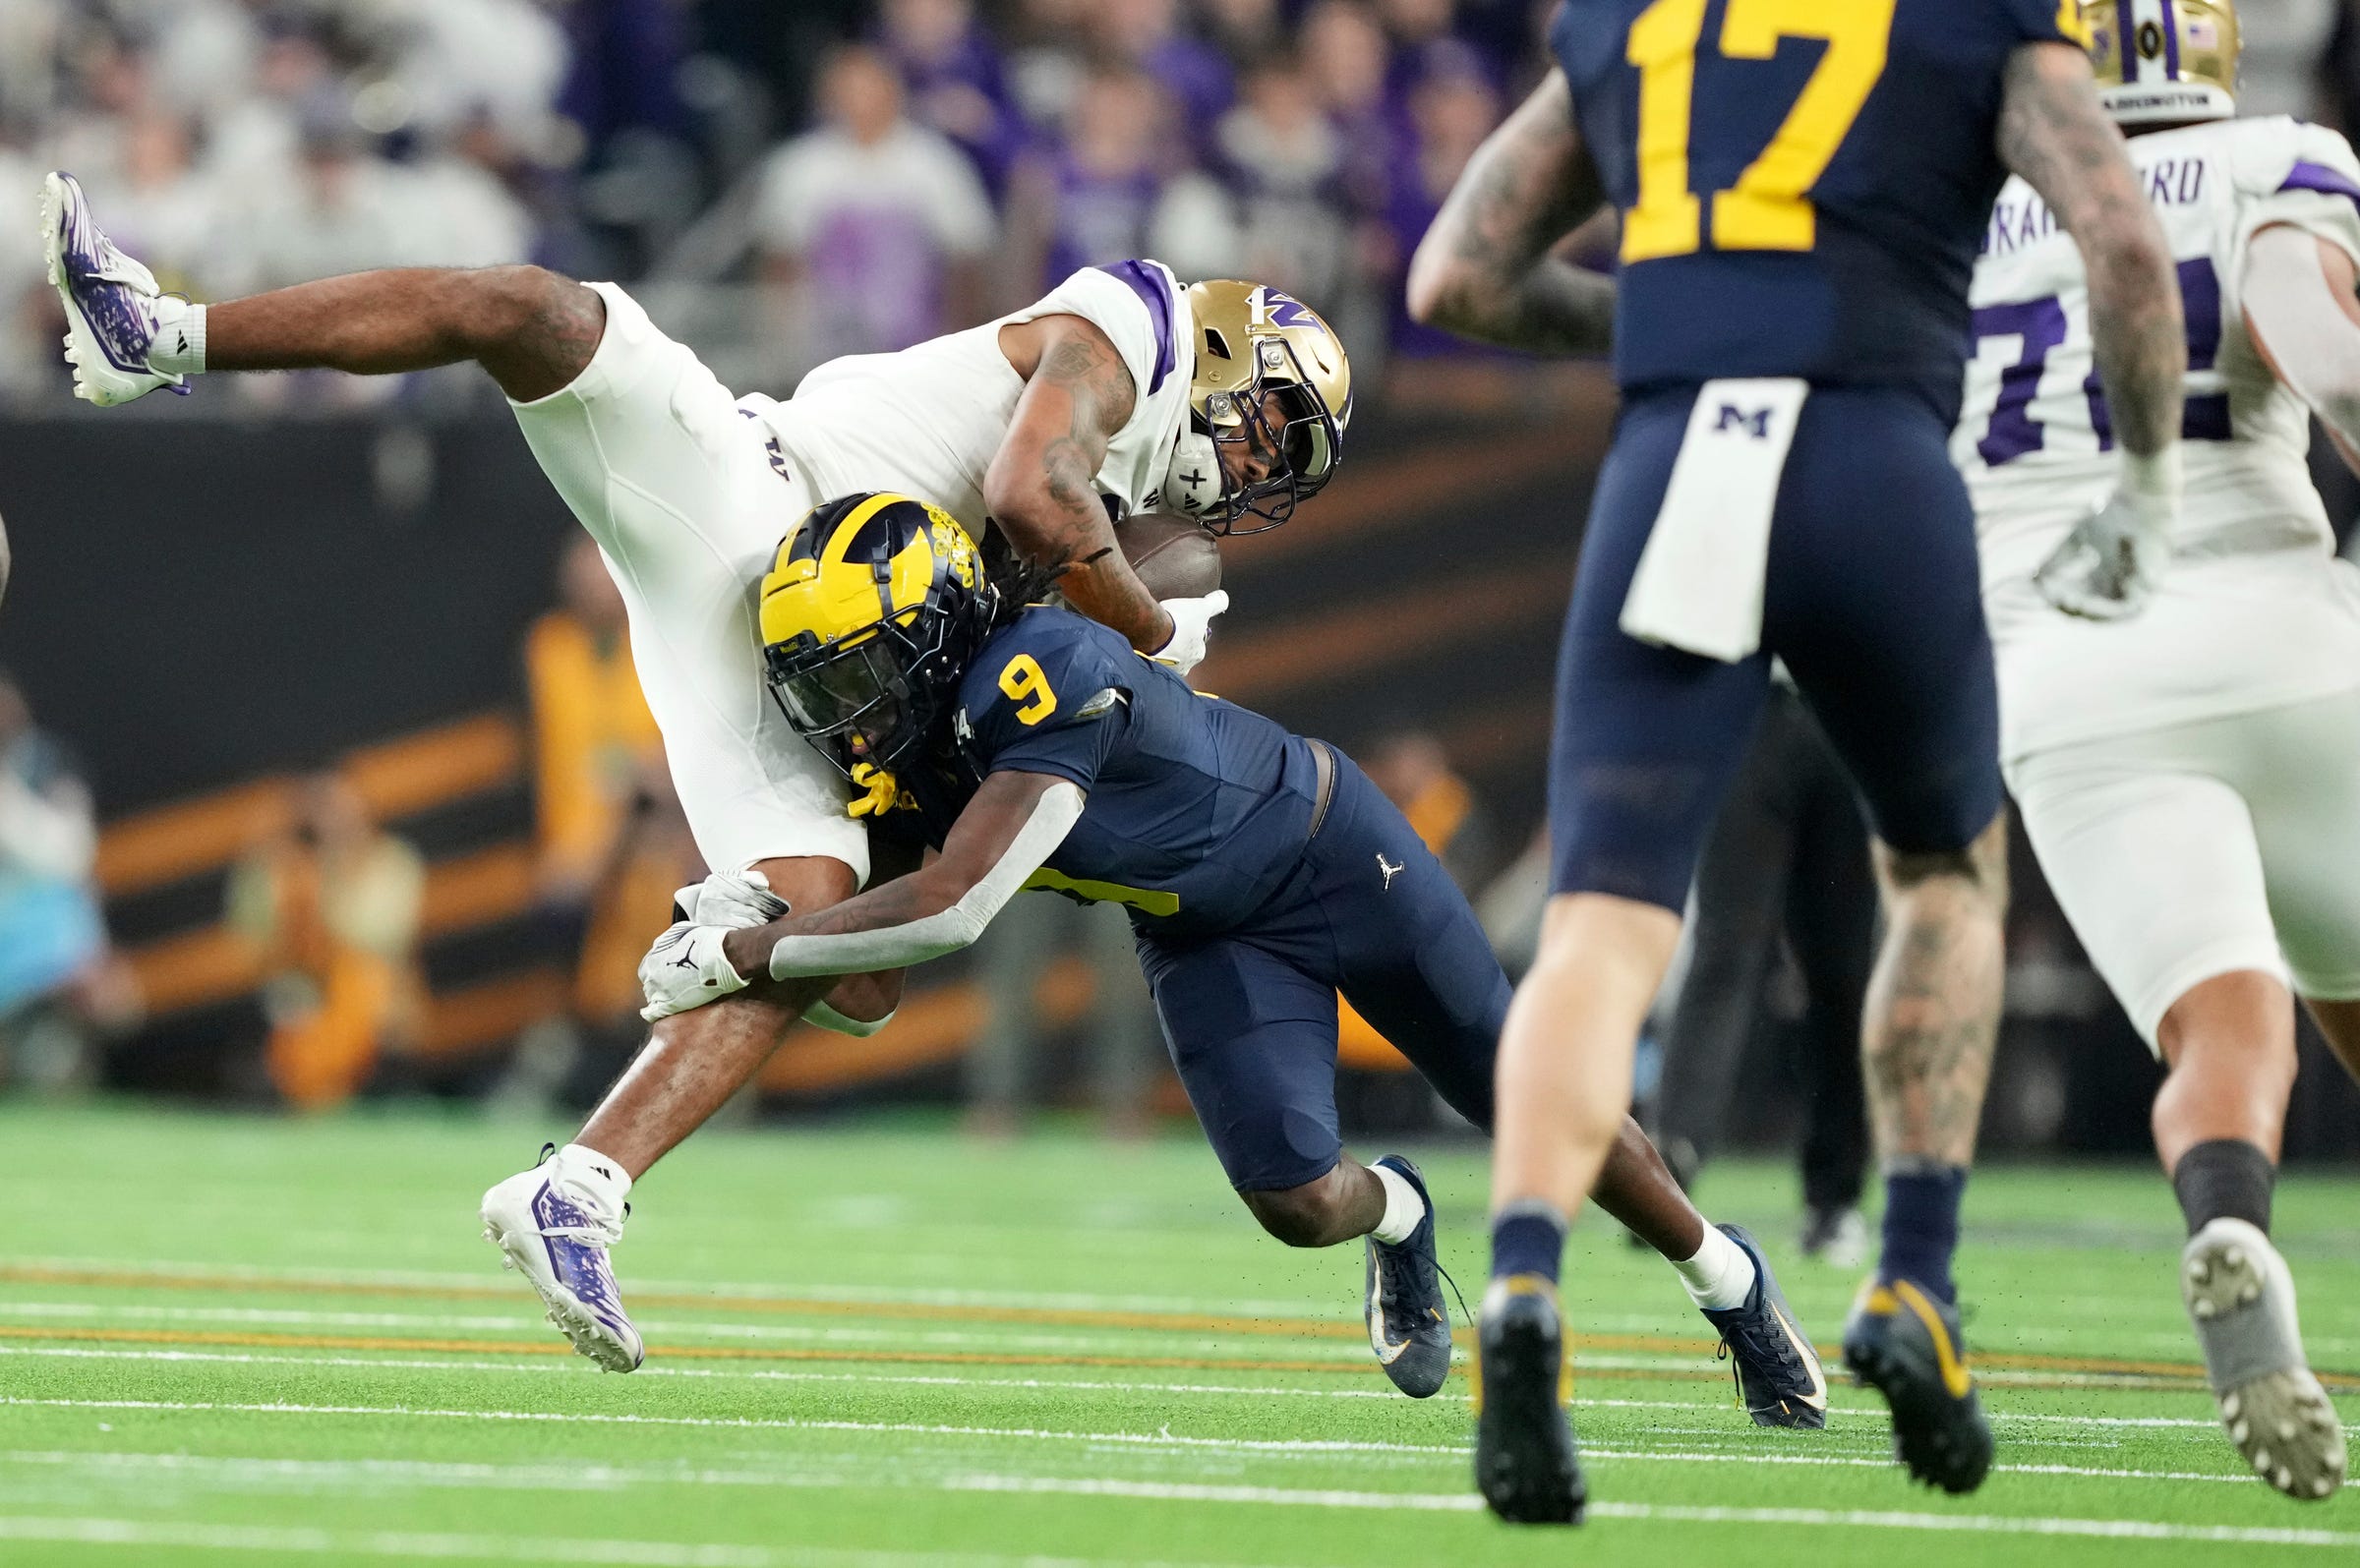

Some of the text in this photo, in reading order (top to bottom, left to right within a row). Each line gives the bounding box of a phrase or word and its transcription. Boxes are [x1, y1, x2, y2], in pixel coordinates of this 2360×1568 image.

[1620, 0, 1898, 265] 17
[1716, 405, 1773, 438] M
[998, 653, 1058, 726] 9
